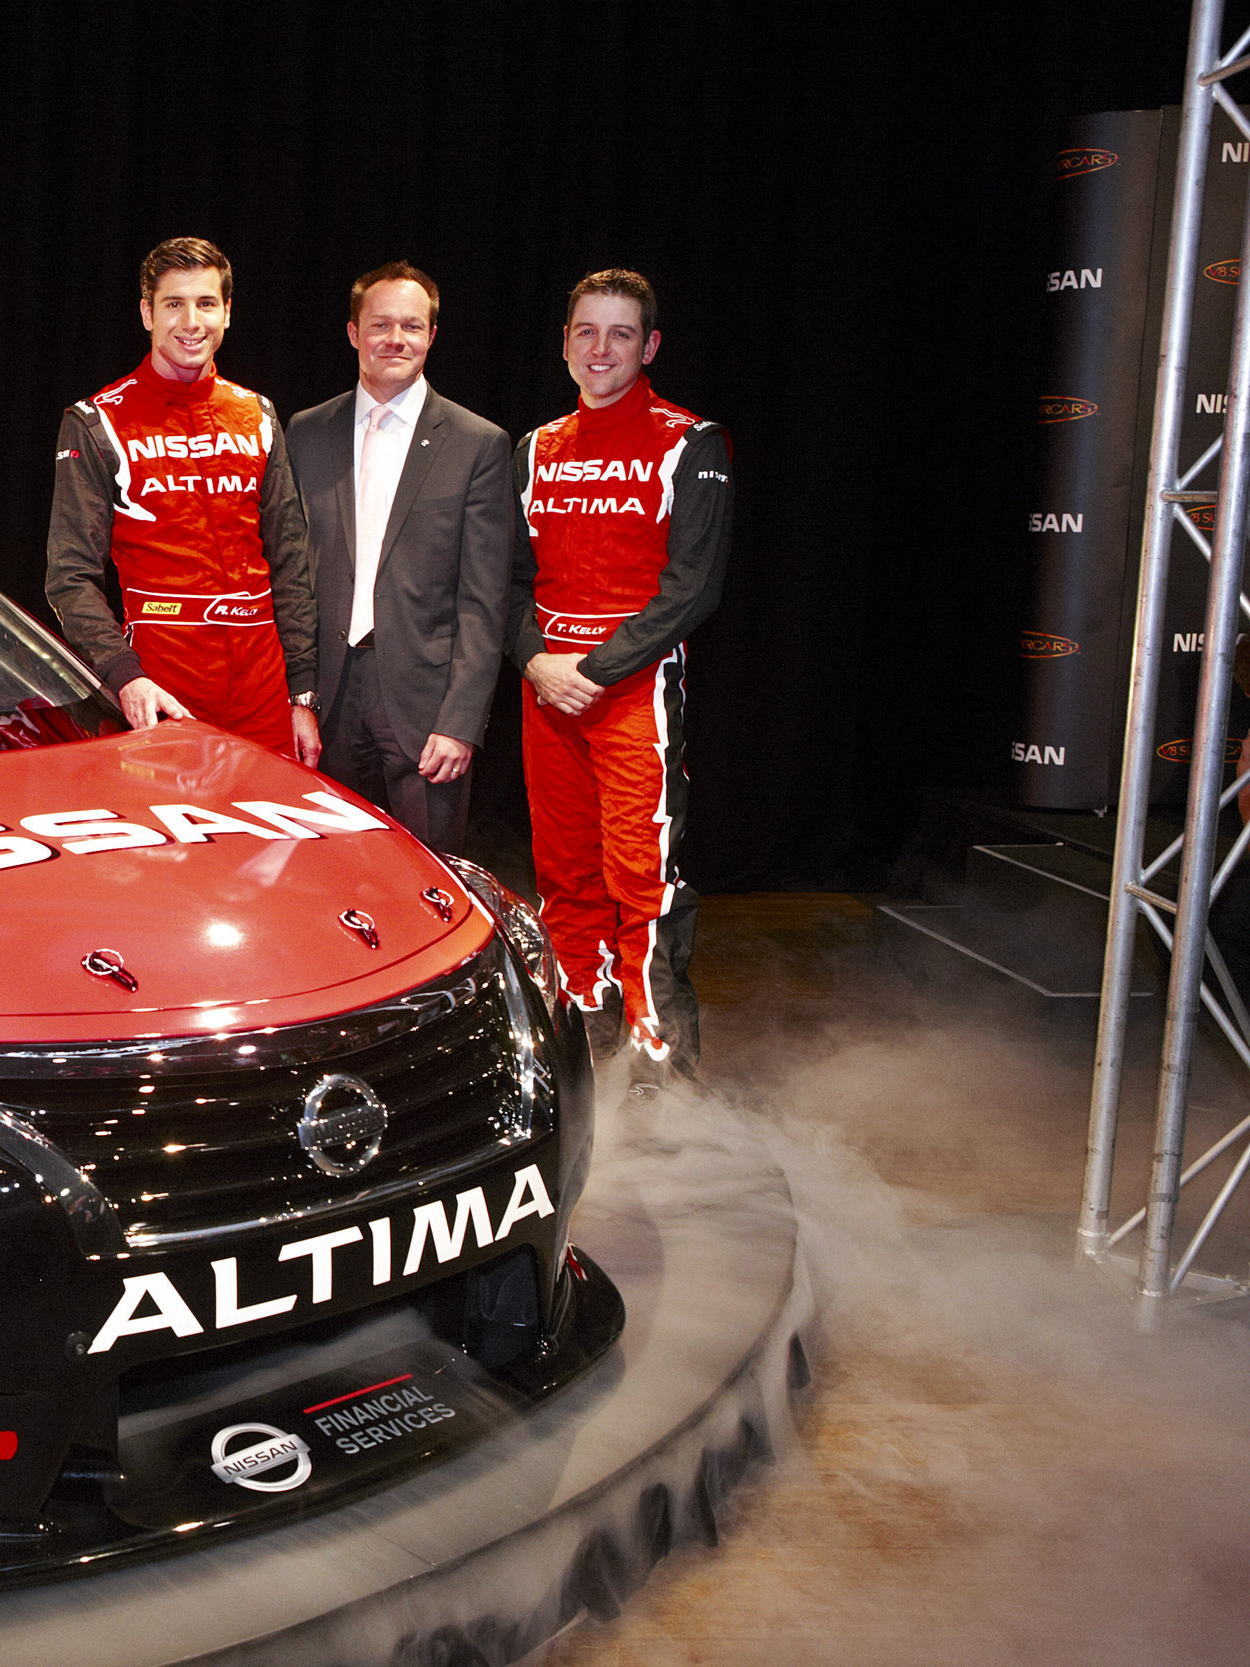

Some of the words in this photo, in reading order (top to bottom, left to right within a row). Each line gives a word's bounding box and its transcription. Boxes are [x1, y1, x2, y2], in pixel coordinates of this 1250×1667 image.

[1221, 142, 1250, 162] NI
[127, 432, 260, 463] NISSAN
[535, 459, 654, 484] NISSAN
[141, 475, 257, 497] ALTIMA
[529, 497, 646, 516] ALTIMA
[145, 602, 178, 614] Sabelt
[214, 605, 229, 616] R.
[557, 623, 567, 633] T.
[568, 624, 607, 635] KELLY
[87, 1164, 555, 1354] ALTIMA
[314, 1386, 434, 1437] FINANCIAL
[335, 1403, 456, 1454] SERVICES
[223, 1440, 297, 1476] NISSAN
